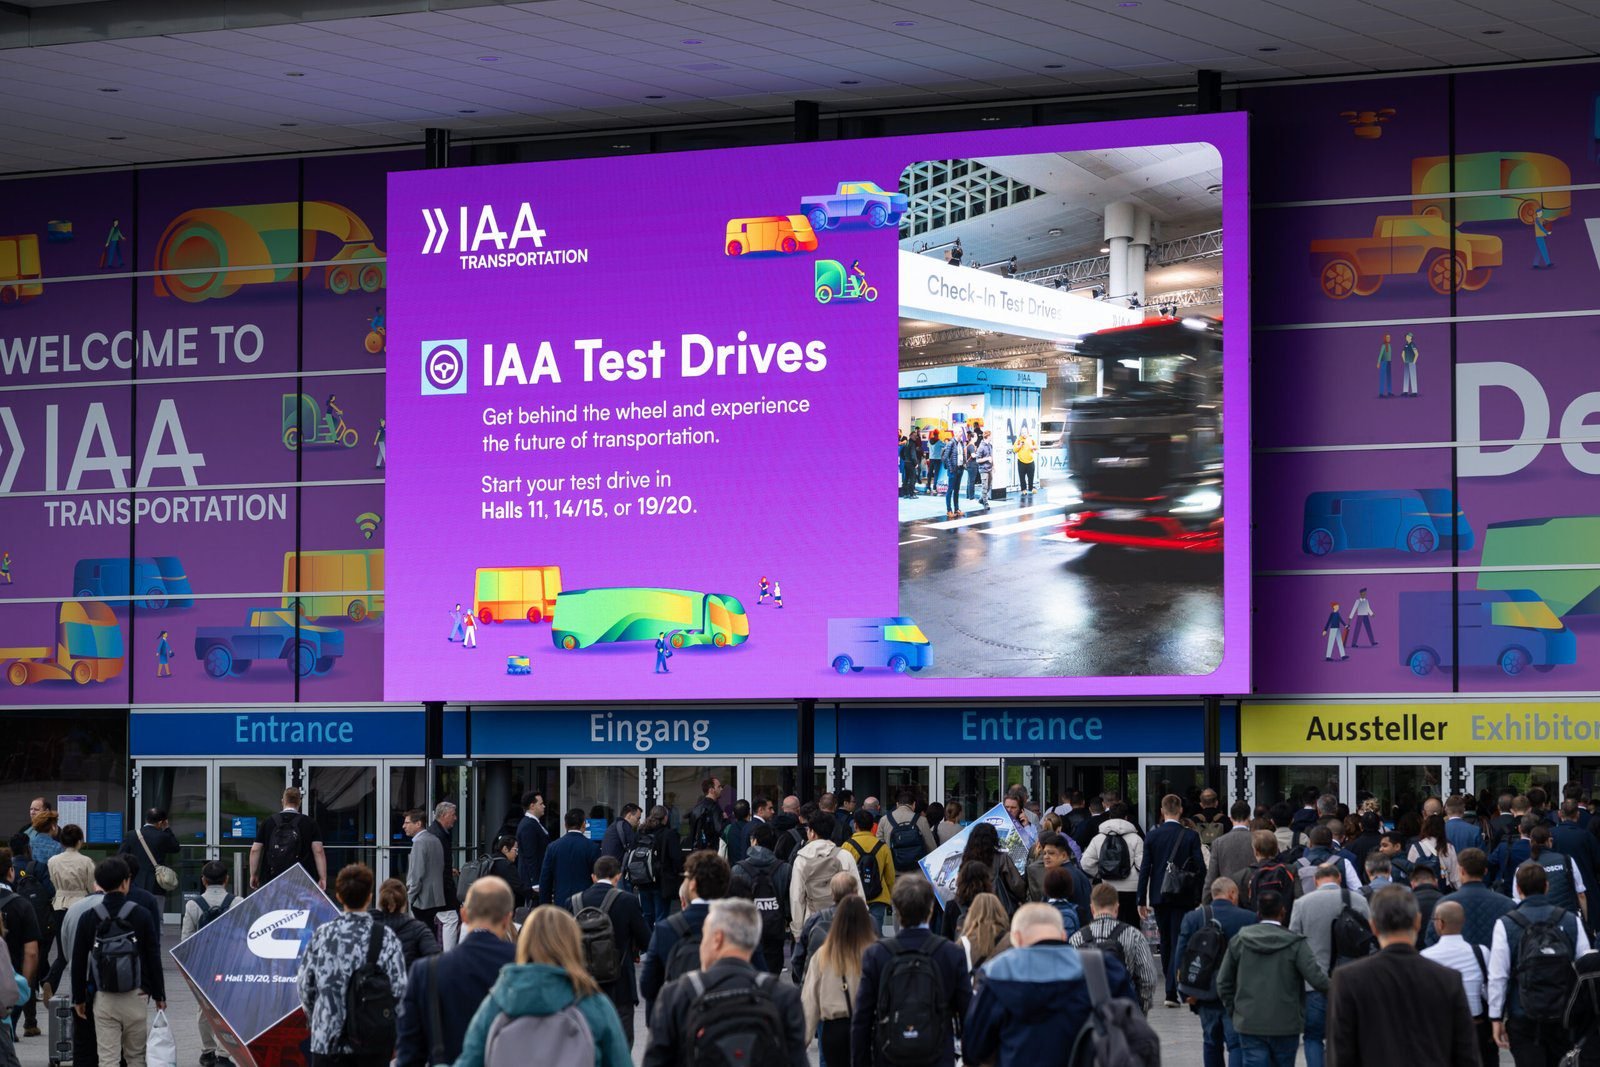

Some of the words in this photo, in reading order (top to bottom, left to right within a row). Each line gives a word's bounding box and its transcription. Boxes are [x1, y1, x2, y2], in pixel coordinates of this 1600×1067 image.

[459, 202, 547, 252] IAA
[460, 249, 588, 270] TRANSPORTATION
[927, 274, 997, 308] Check-In
[1000, 290, 1025, 312] Test
[0, 327, 199, 375] WELCOME
[211, 323, 265, 364] TO
[483, 341, 561, 386] IAA
[575, 338, 665, 382] Test
[681, 331, 827, 378] Drives
[482, 408, 514, 426] Get
[518, 404, 577, 424] behind
[583, 403, 611, 422] the
[616, 400, 667, 420] wheel
[672, 398, 705, 418] and
[711, 396, 810, 420] experience
[46, 399, 206, 492] IAA
[482, 434, 509, 452] the
[514, 433, 566, 451] future
[570, 430, 588, 448] of
[593, 427, 720, 451] transportation.
[481, 475, 522, 493] Start
[527, 478, 565, 497] your
[570, 473, 601, 490] test
[606, 471, 650, 489] drive
[656, 469, 671, 488] in
[44, 493, 287, 527] TRANSPORTATION
[481, 500, 523, 519] Halls
[528, 500, 549, 520] 11,
[553, 498, 608, 518] 14/15,
[613, 502, 632, 516] or
[637, 495, 697, 515] 19/20.
[235, 715, 354, 743] Entrance
[590, 712, 710, 752] Eingang
[961, 711, 1103, 741] Entrance
[1306, 713, 1448, 742] Aussteller
[1542, 864, 1564, 873] OSCH
[754, 897, 780, 911] ANS
[248, 909, 305, 940] Cummins
[225, 974, 243, 982] Hall
[245, 974, 270, 984] 19/20,
[272, 974, 298, 983] Stand
